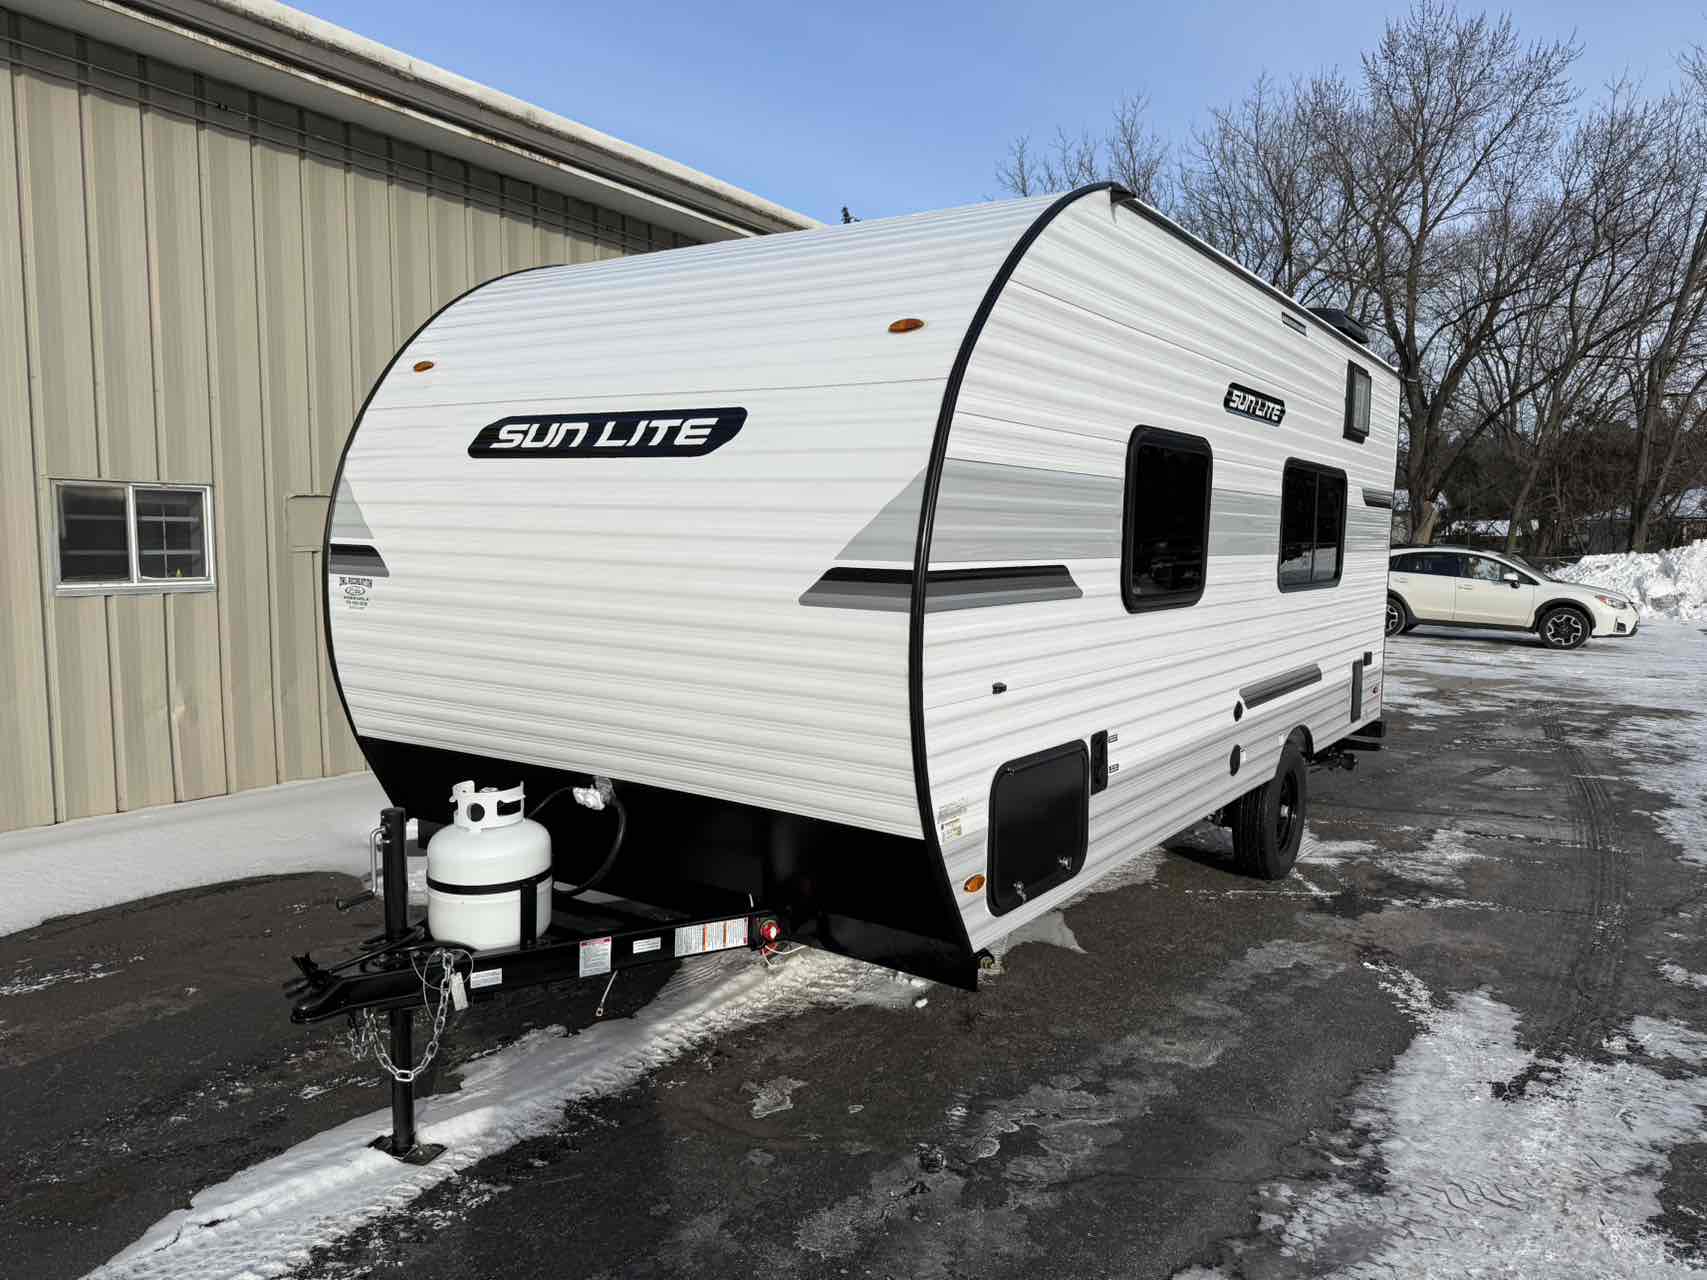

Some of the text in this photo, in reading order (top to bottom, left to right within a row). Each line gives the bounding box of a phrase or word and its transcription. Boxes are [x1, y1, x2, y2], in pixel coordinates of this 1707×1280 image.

[1229, 390, 1281, 421] SUN LITE
[489, 417, 719, 448] SUN LITE
